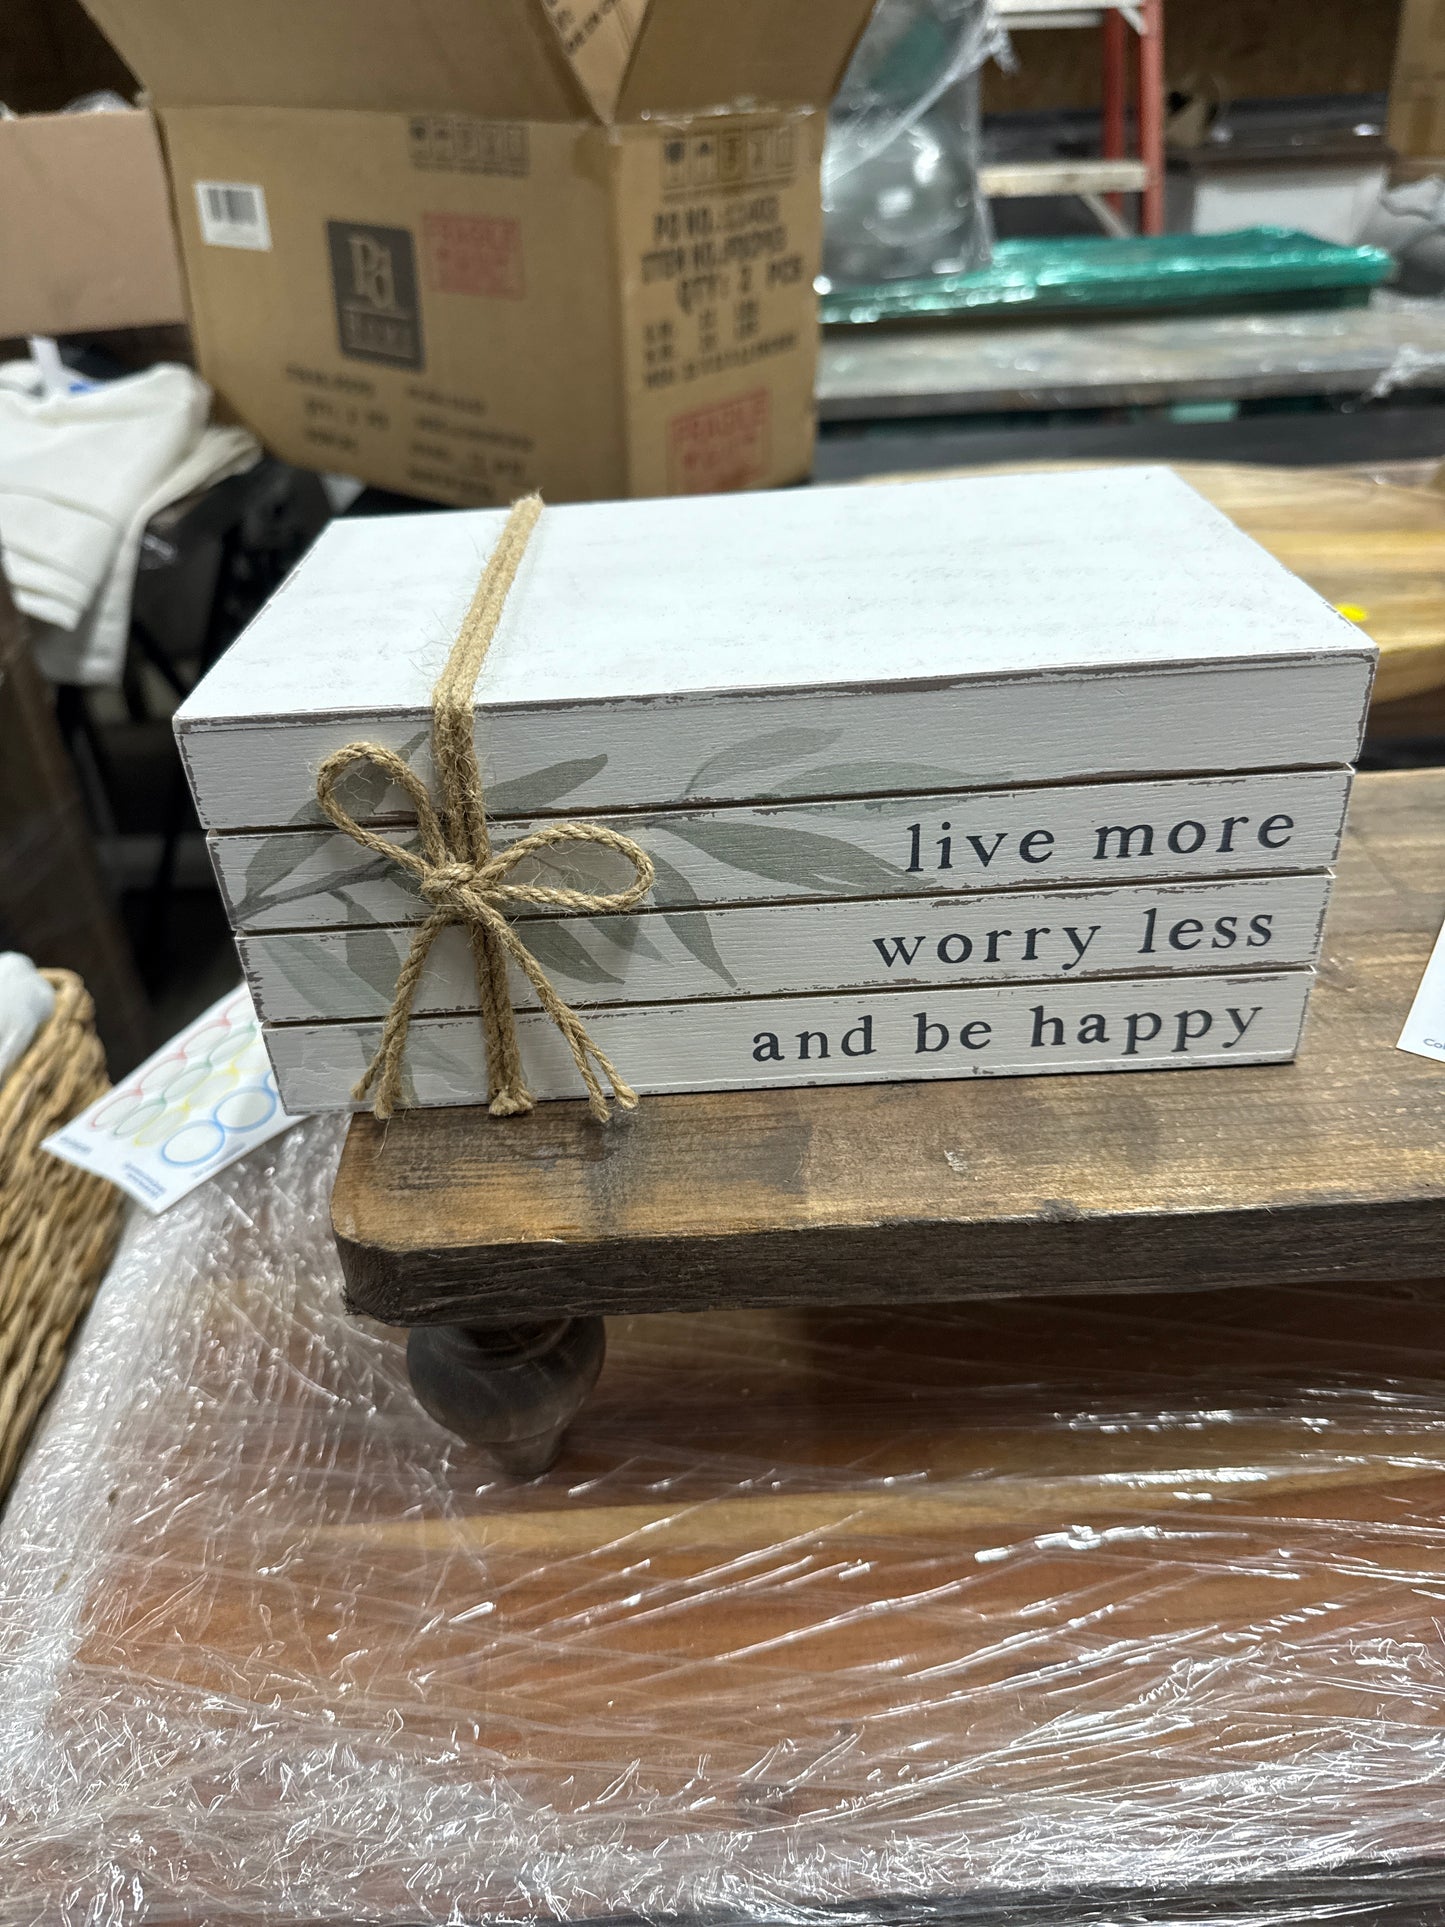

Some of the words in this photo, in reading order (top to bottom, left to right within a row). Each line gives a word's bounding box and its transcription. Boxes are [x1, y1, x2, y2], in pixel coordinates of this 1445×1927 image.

[904, 821, 1056, 873] live
[1092, 813, 1296, 862] more
[872, 923, 1102, 971] worry
[1136, 907, 1275, 955] less
[751, 1014, 878, 1063] and
[912, 1012, 993, 1055] be
[1029, 1004, 1264, 1056] happy
